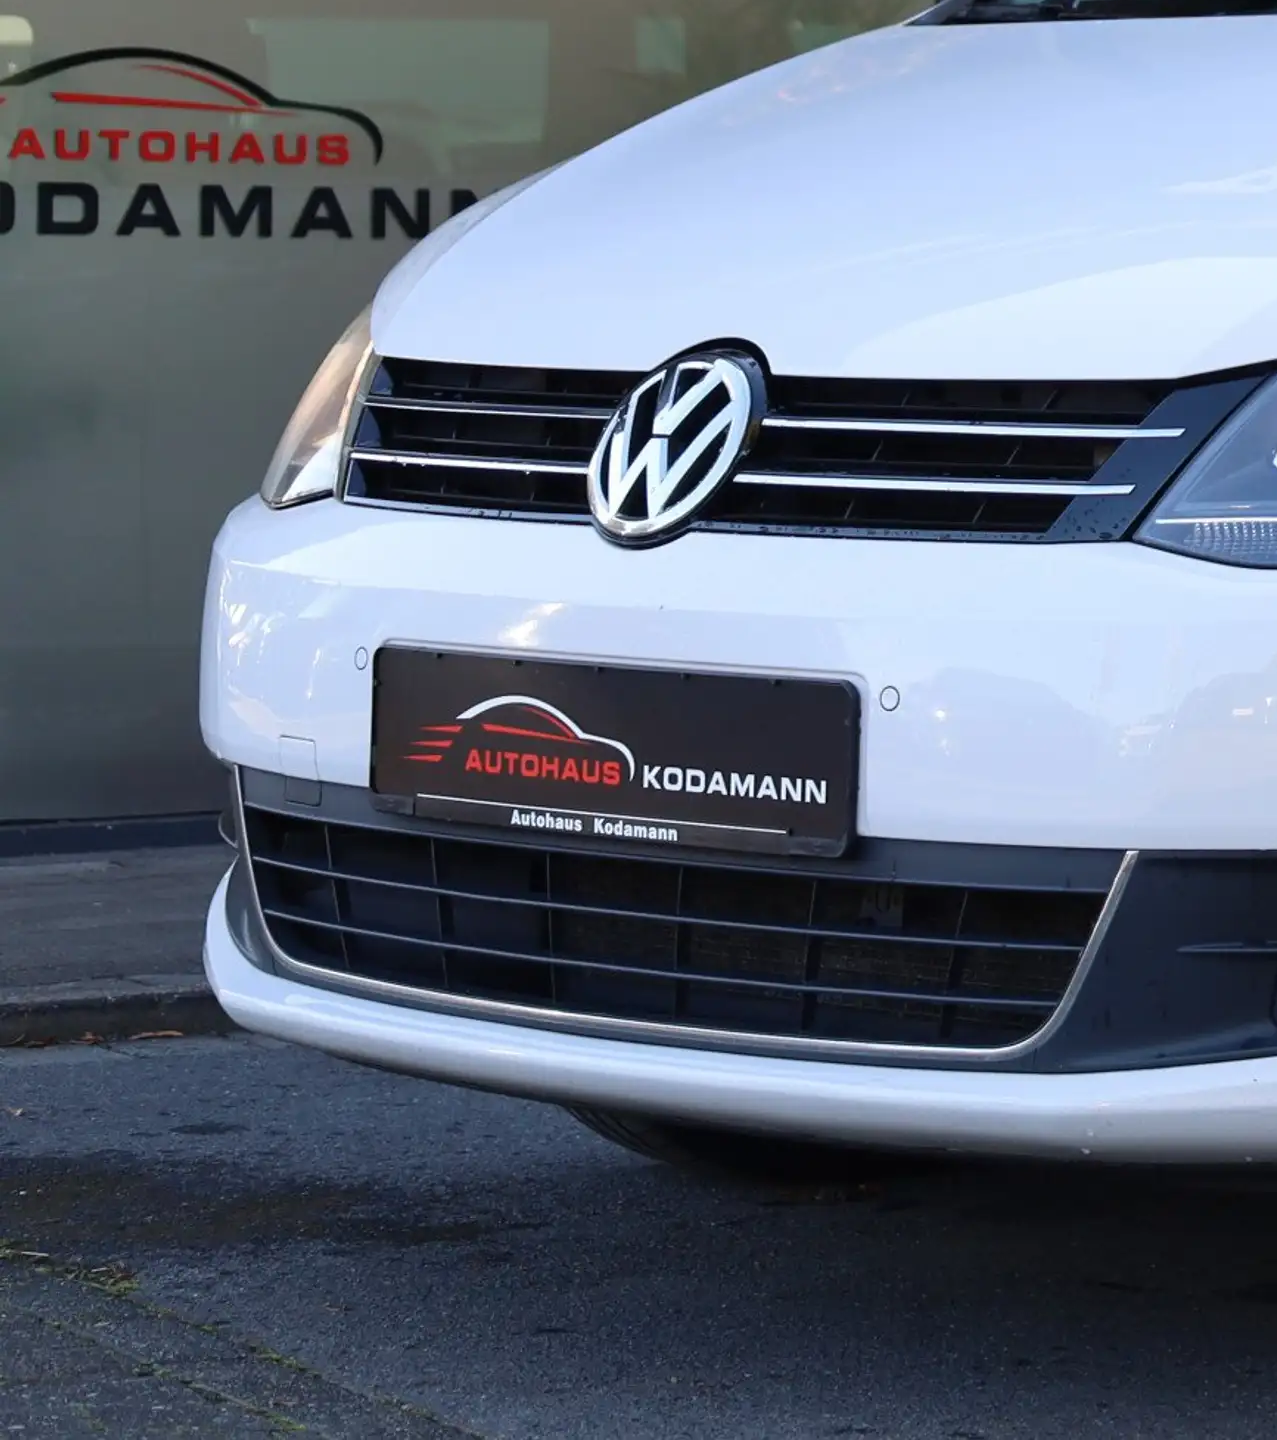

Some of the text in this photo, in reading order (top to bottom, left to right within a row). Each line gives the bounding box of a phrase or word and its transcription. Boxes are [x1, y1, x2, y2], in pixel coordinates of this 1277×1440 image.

[9, 127, 350, 166] AUTOHAUS
[0, 180, 494, 240] DAMAN
[465, 748, 828, 805] AUTOHAUS KODAMANN
[510, 807, 679, 842] Autohaus Kodamann
